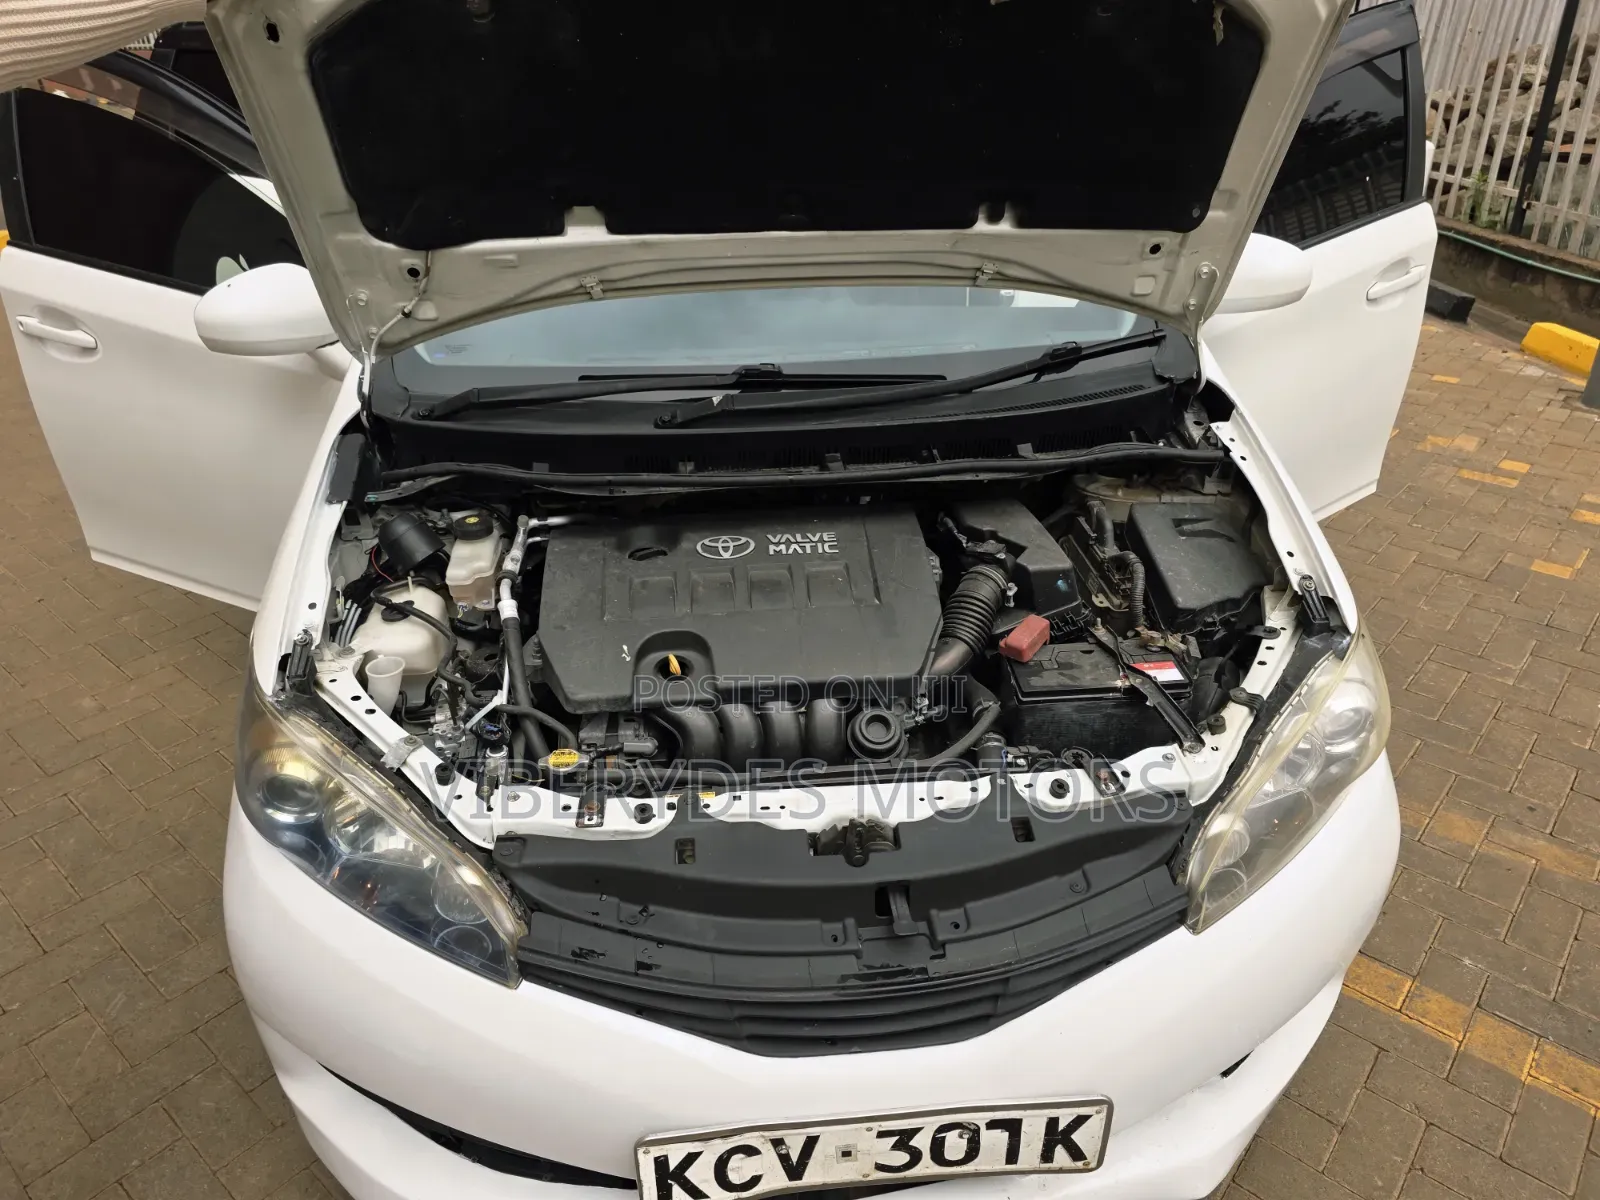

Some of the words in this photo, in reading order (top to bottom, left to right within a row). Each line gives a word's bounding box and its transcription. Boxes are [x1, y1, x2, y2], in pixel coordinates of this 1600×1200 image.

[766, 532, 837, 543] VALVE
[768, 542, 839, 555] MATIC
[653, 1134, 821, 1200] KCV
[874, 1114, 1094, 1174] 301K
